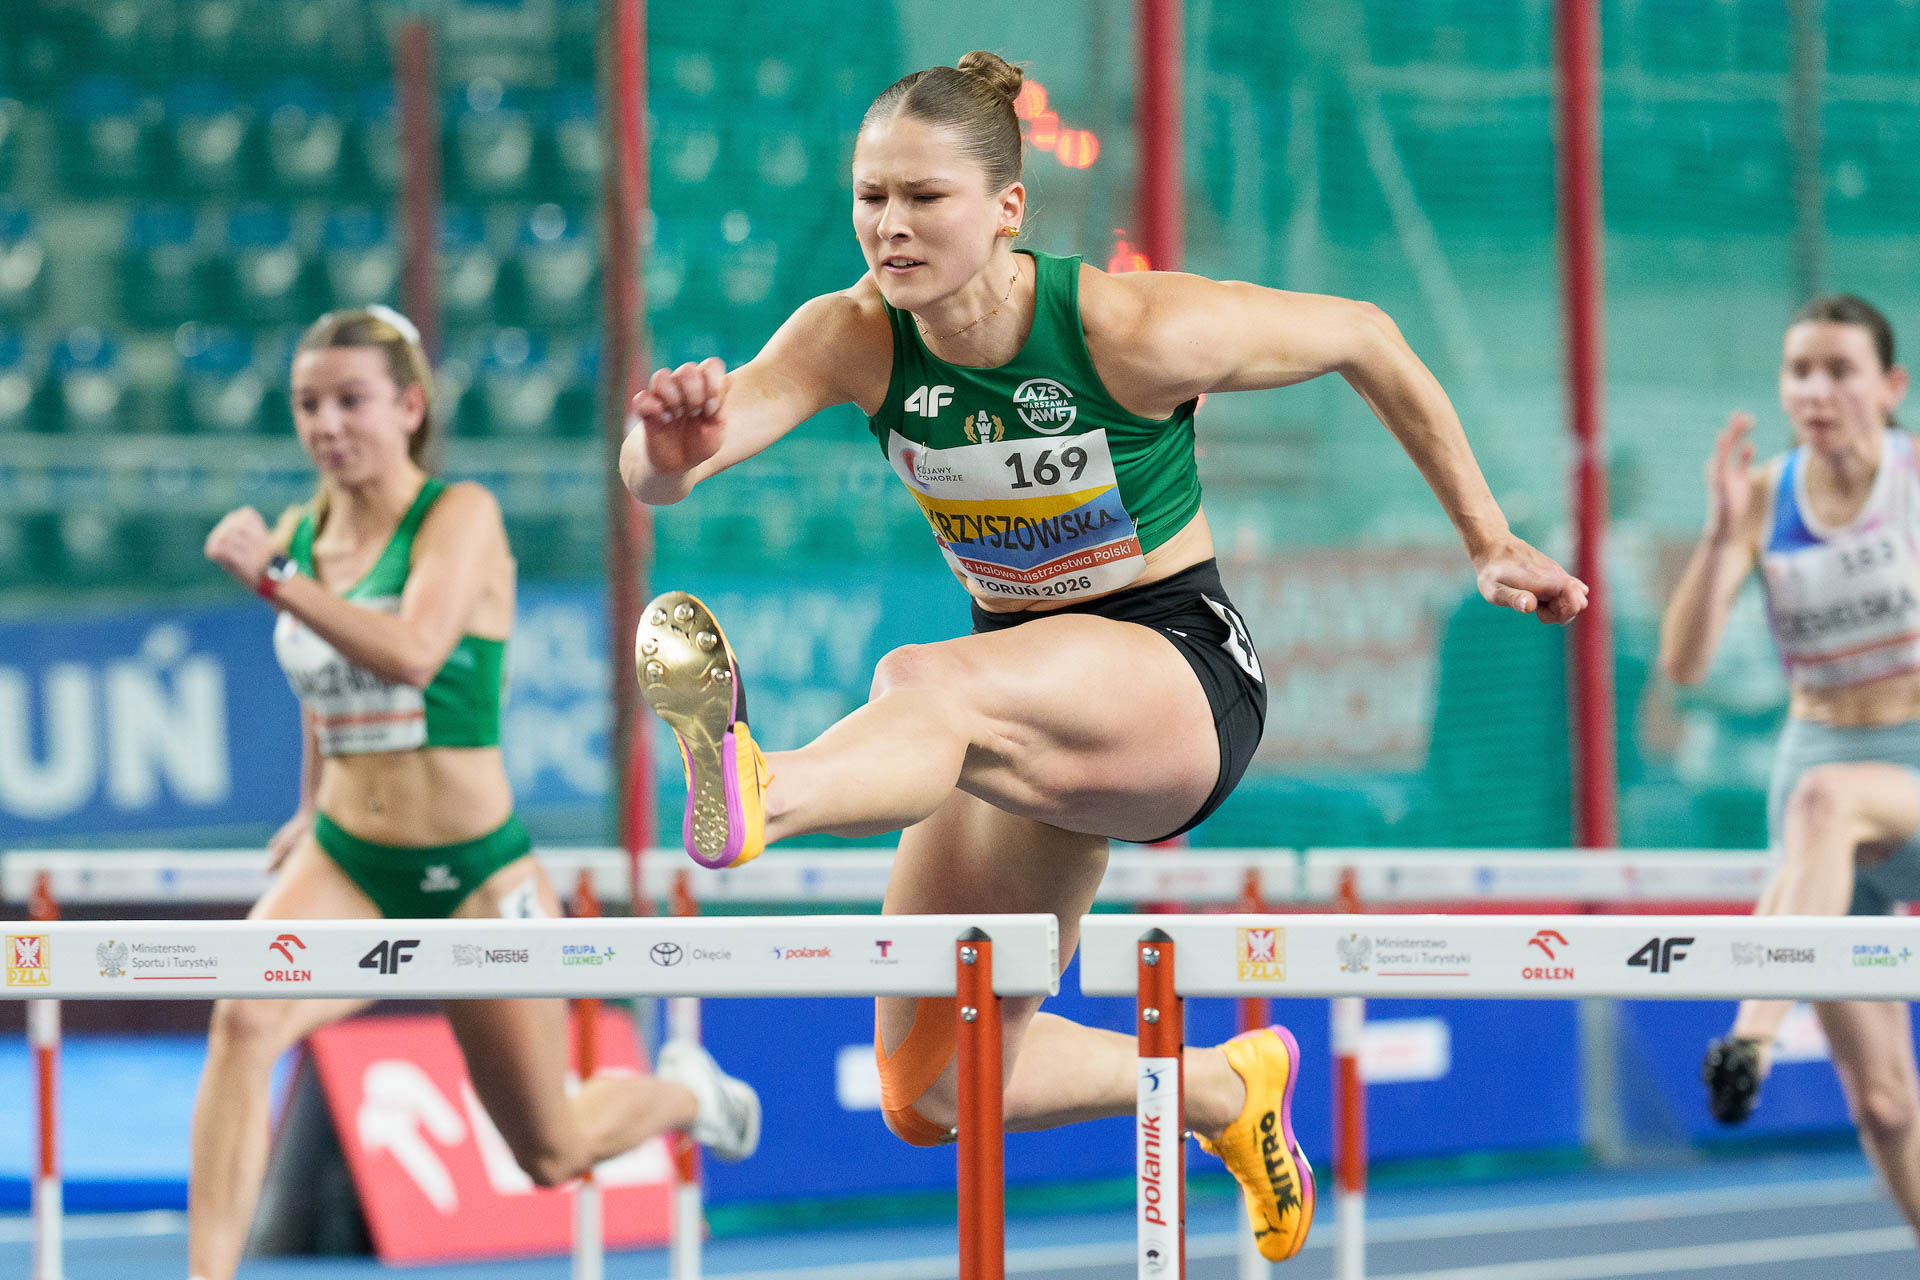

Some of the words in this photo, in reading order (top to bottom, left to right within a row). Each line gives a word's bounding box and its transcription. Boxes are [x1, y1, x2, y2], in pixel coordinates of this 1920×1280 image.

[904, 384, 955, 418] 4F
[1025, 386, 1060, 402] AZS
[1021, 399, 1069, 409] WARSZAWA
[1030, 407, 1067, 422] AWF
[1003, 445, 1089, 490] 169
[974, 563, 1017, 580] Halowe
[1018, 555, 1093, 582] Mistrzostwa
[1093, 542, 1132, 562] Polski
[975, 576, 1040, 597] TORUŃ
[1041, 575, 1092, 597] 2026
[131, 943, 197, 954] Ministerstwo
[562, 944, 597, 955] GRUPA
[1375, 937, 1448, 949] Ministerstwo
[358, 939, 421, 975] 4F
[485, 948, 529, 964] Nestlé
[562, 956, 604, 966] LUXMED
[692, 948, 732, 962] Okęcie
[785, 947, 832, 960] polanik
[1626, 937, 1696, 974] 4F
[131, 957, 165, 969] Sportu
[173, 956, 219, 969] Turystyki
[8, 969, 48, 984] PZLA
[264, 969, 312, 983] ORLEN
[1238, 963, 1283, 979] PZLA
[1522, 967, 1575, 980] ORLEN
[1141, 1113, 1167, 1227] polanik
[1259, 1109, 1301, 1222] NITRO
